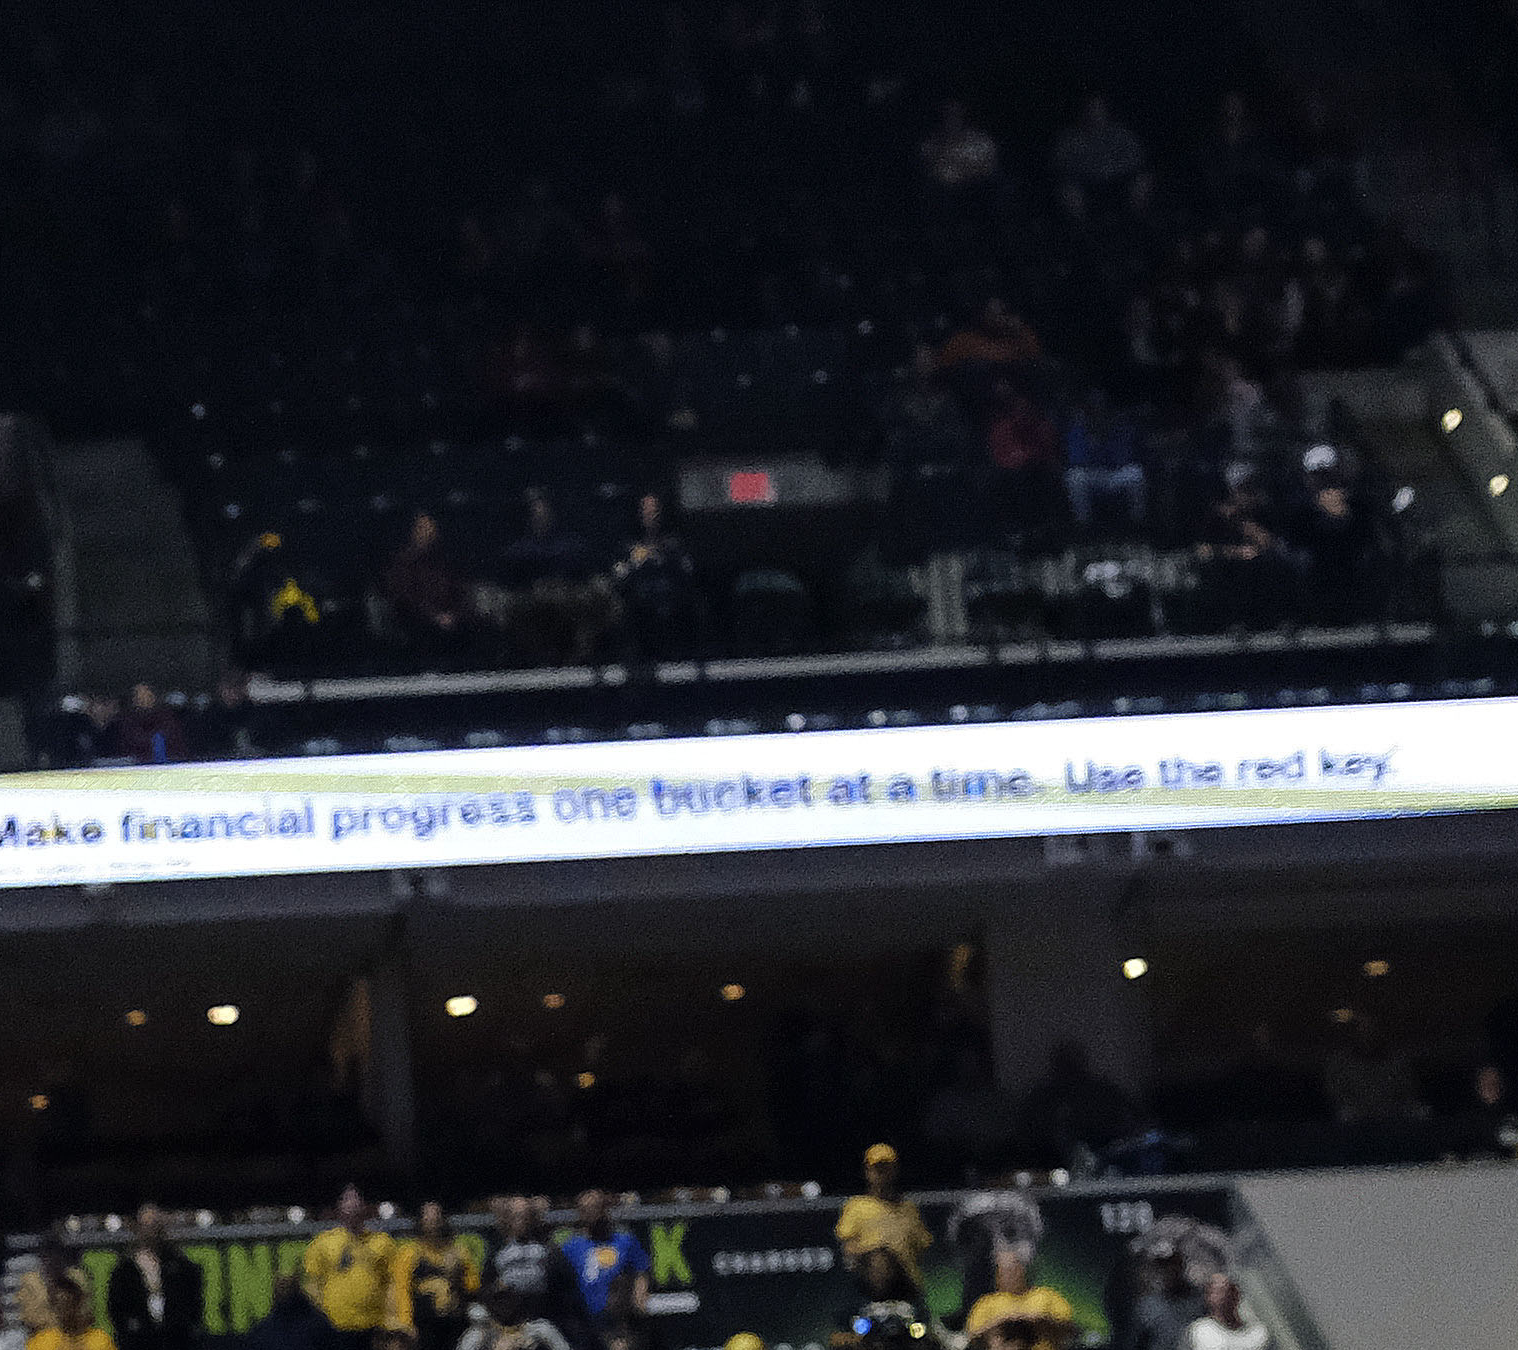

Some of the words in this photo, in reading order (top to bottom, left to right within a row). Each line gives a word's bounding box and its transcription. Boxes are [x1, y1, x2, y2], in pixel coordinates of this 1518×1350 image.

[120, 797, 315, 843] financial
[331, 788, 536, 842] progress
[552, 784, 638, 825] one
[650, 774, 812, 818] bucket
[828, 771, 873, 806] at
[887, 774, 917, 802] a
[1063, 758, 1144, 794] Use
[1158, 756, 1223, 789] the
[1236, 749, 1306, 784] red
